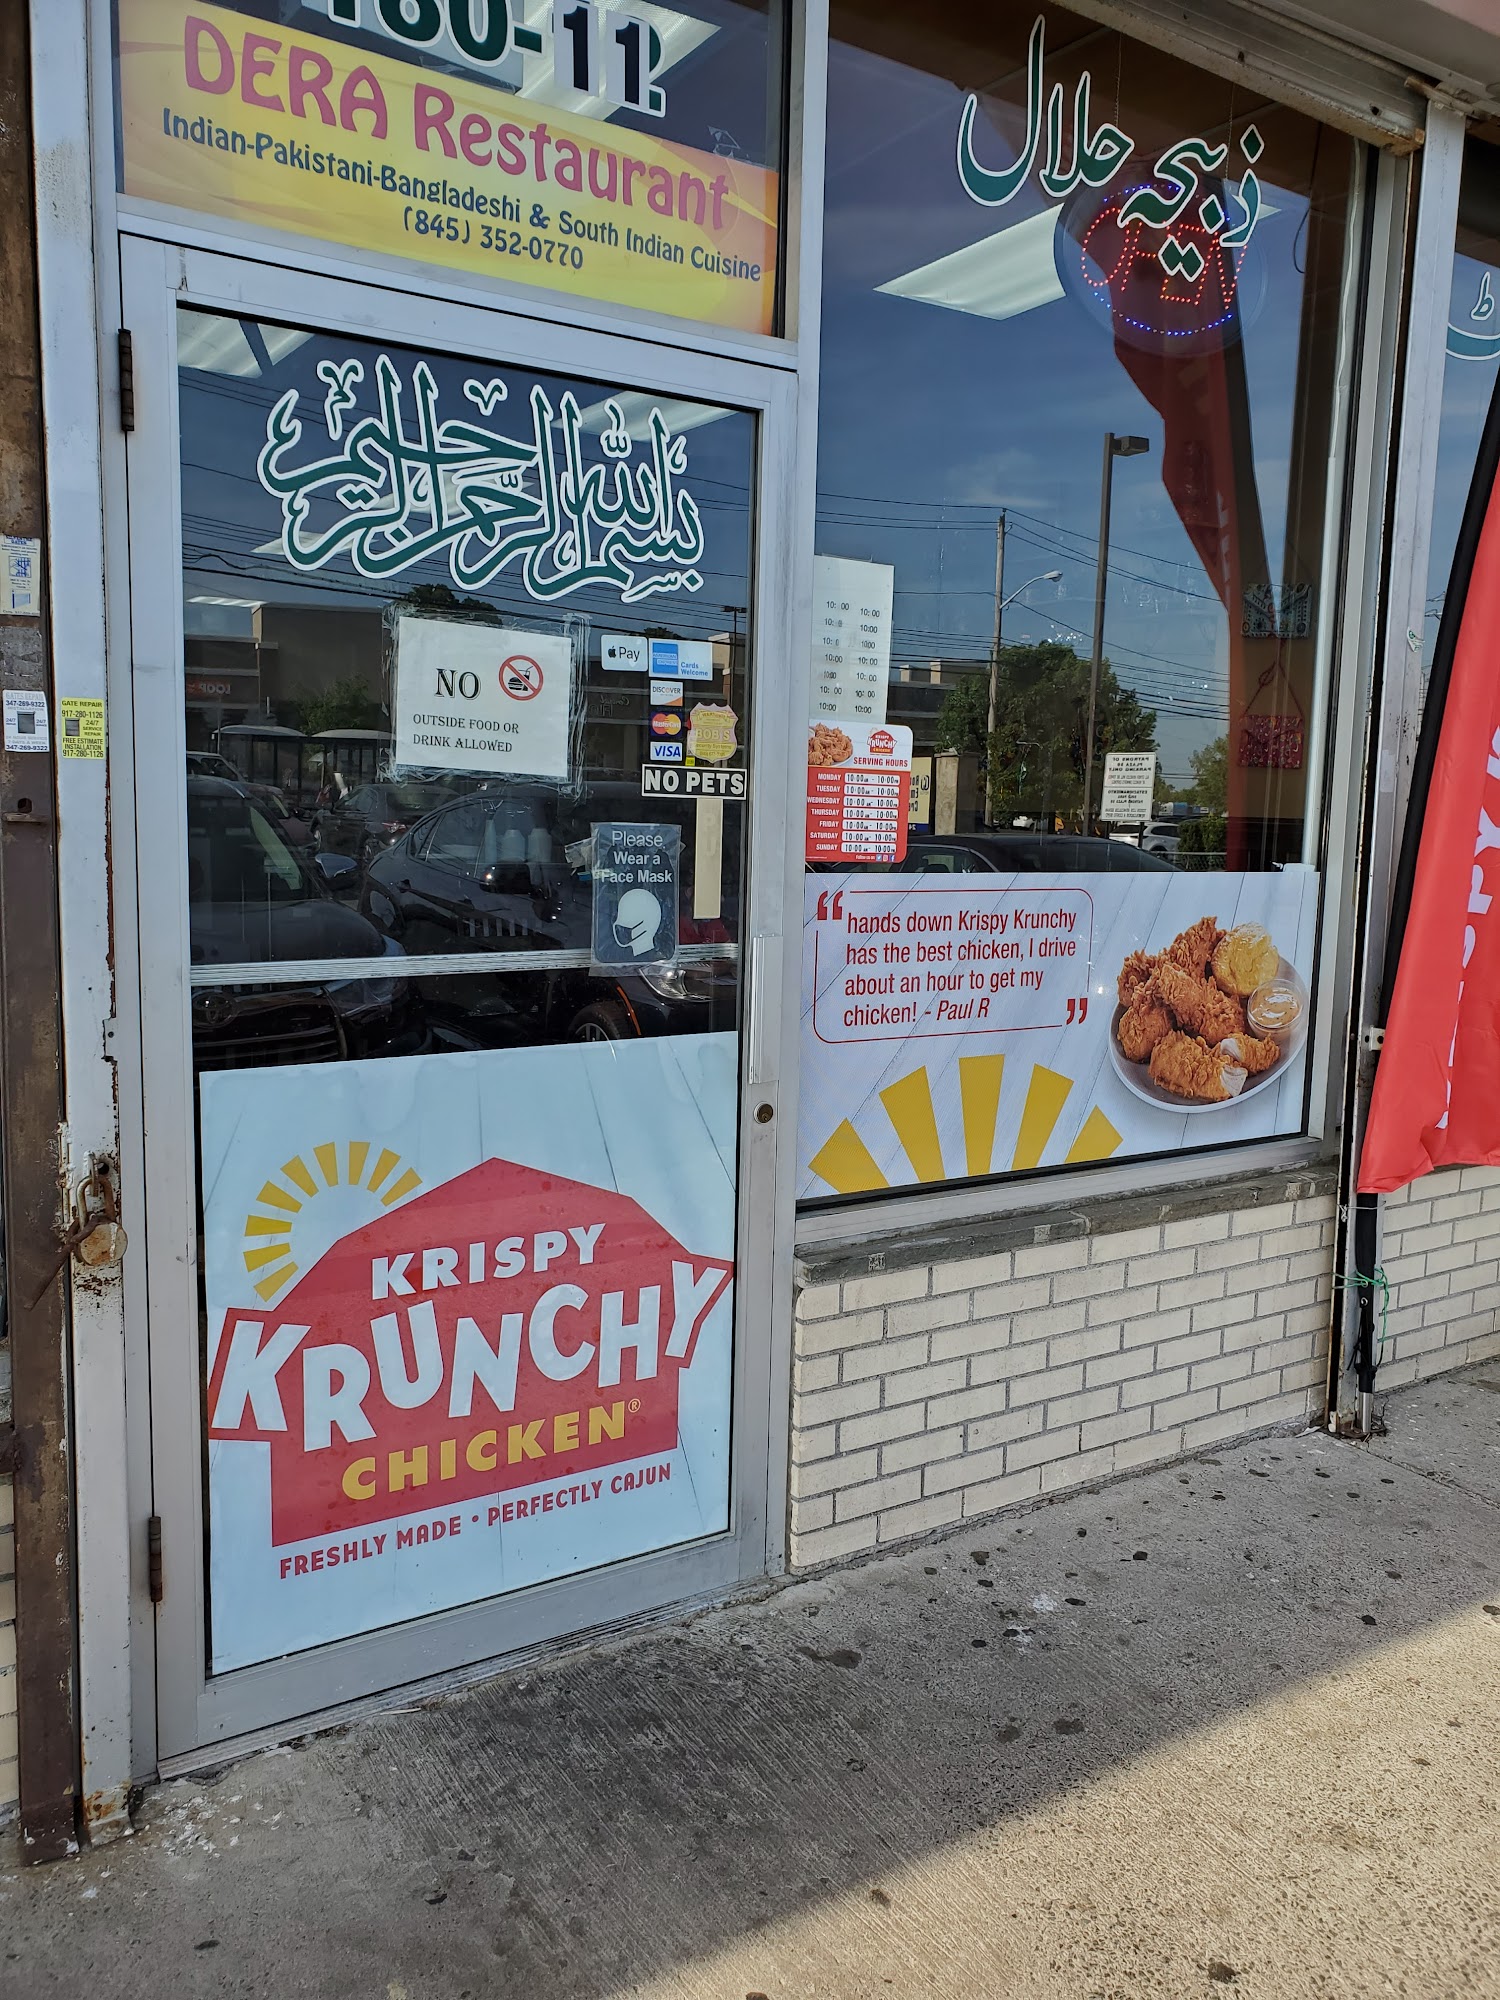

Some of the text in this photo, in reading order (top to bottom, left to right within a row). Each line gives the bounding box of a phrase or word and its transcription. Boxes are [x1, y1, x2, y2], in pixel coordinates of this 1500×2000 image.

[184, 16, 729, 230] DERA Restaurant
[163, 107, 761, 282] Indian-Pakistani-Bangladeshi & South Indian Cuisine
[403, 206, 584, 270] (845) 352-0770
[618, 646, 640, 662] Pay
[434, 668, 481, 700] NO
[652, 686, 681, 694] DISCOVER
[413, 713, 519, 734] OUTSIDE FOOD OR
[652, 720, 682, 729] MasterCard
[413, 734, 513, 752] DRINK ALLOWED
[654, 745, 681, 757] VISA
[867, 737, 897, 748] KRUNCHY
[853, 757, 883, 766] SERVING
[645, 769, 744, 795] NO PETS
[614, 851, 661, 865] Wear a
[602, 869, 673, 883] Face Mask
[847, 909, 1077, 937] hands down Krispy Krunchy
[846, 937, 1076, 965] has the best chicken, I drive
[845, 968, 1044, 996] about an hour to get my
[844, 1002, 917, 1026] chicken!
[936, 1000, 973, 1021] Paul
[977, 998, 990, 1018] R
[371, 1222, 606, 1300] KRISPY
[211, 1260, 728, 1453] KRUNCHY
[279, 1462, 672, 1580] FRESHLY MADE PERFECTLY CAJUN
